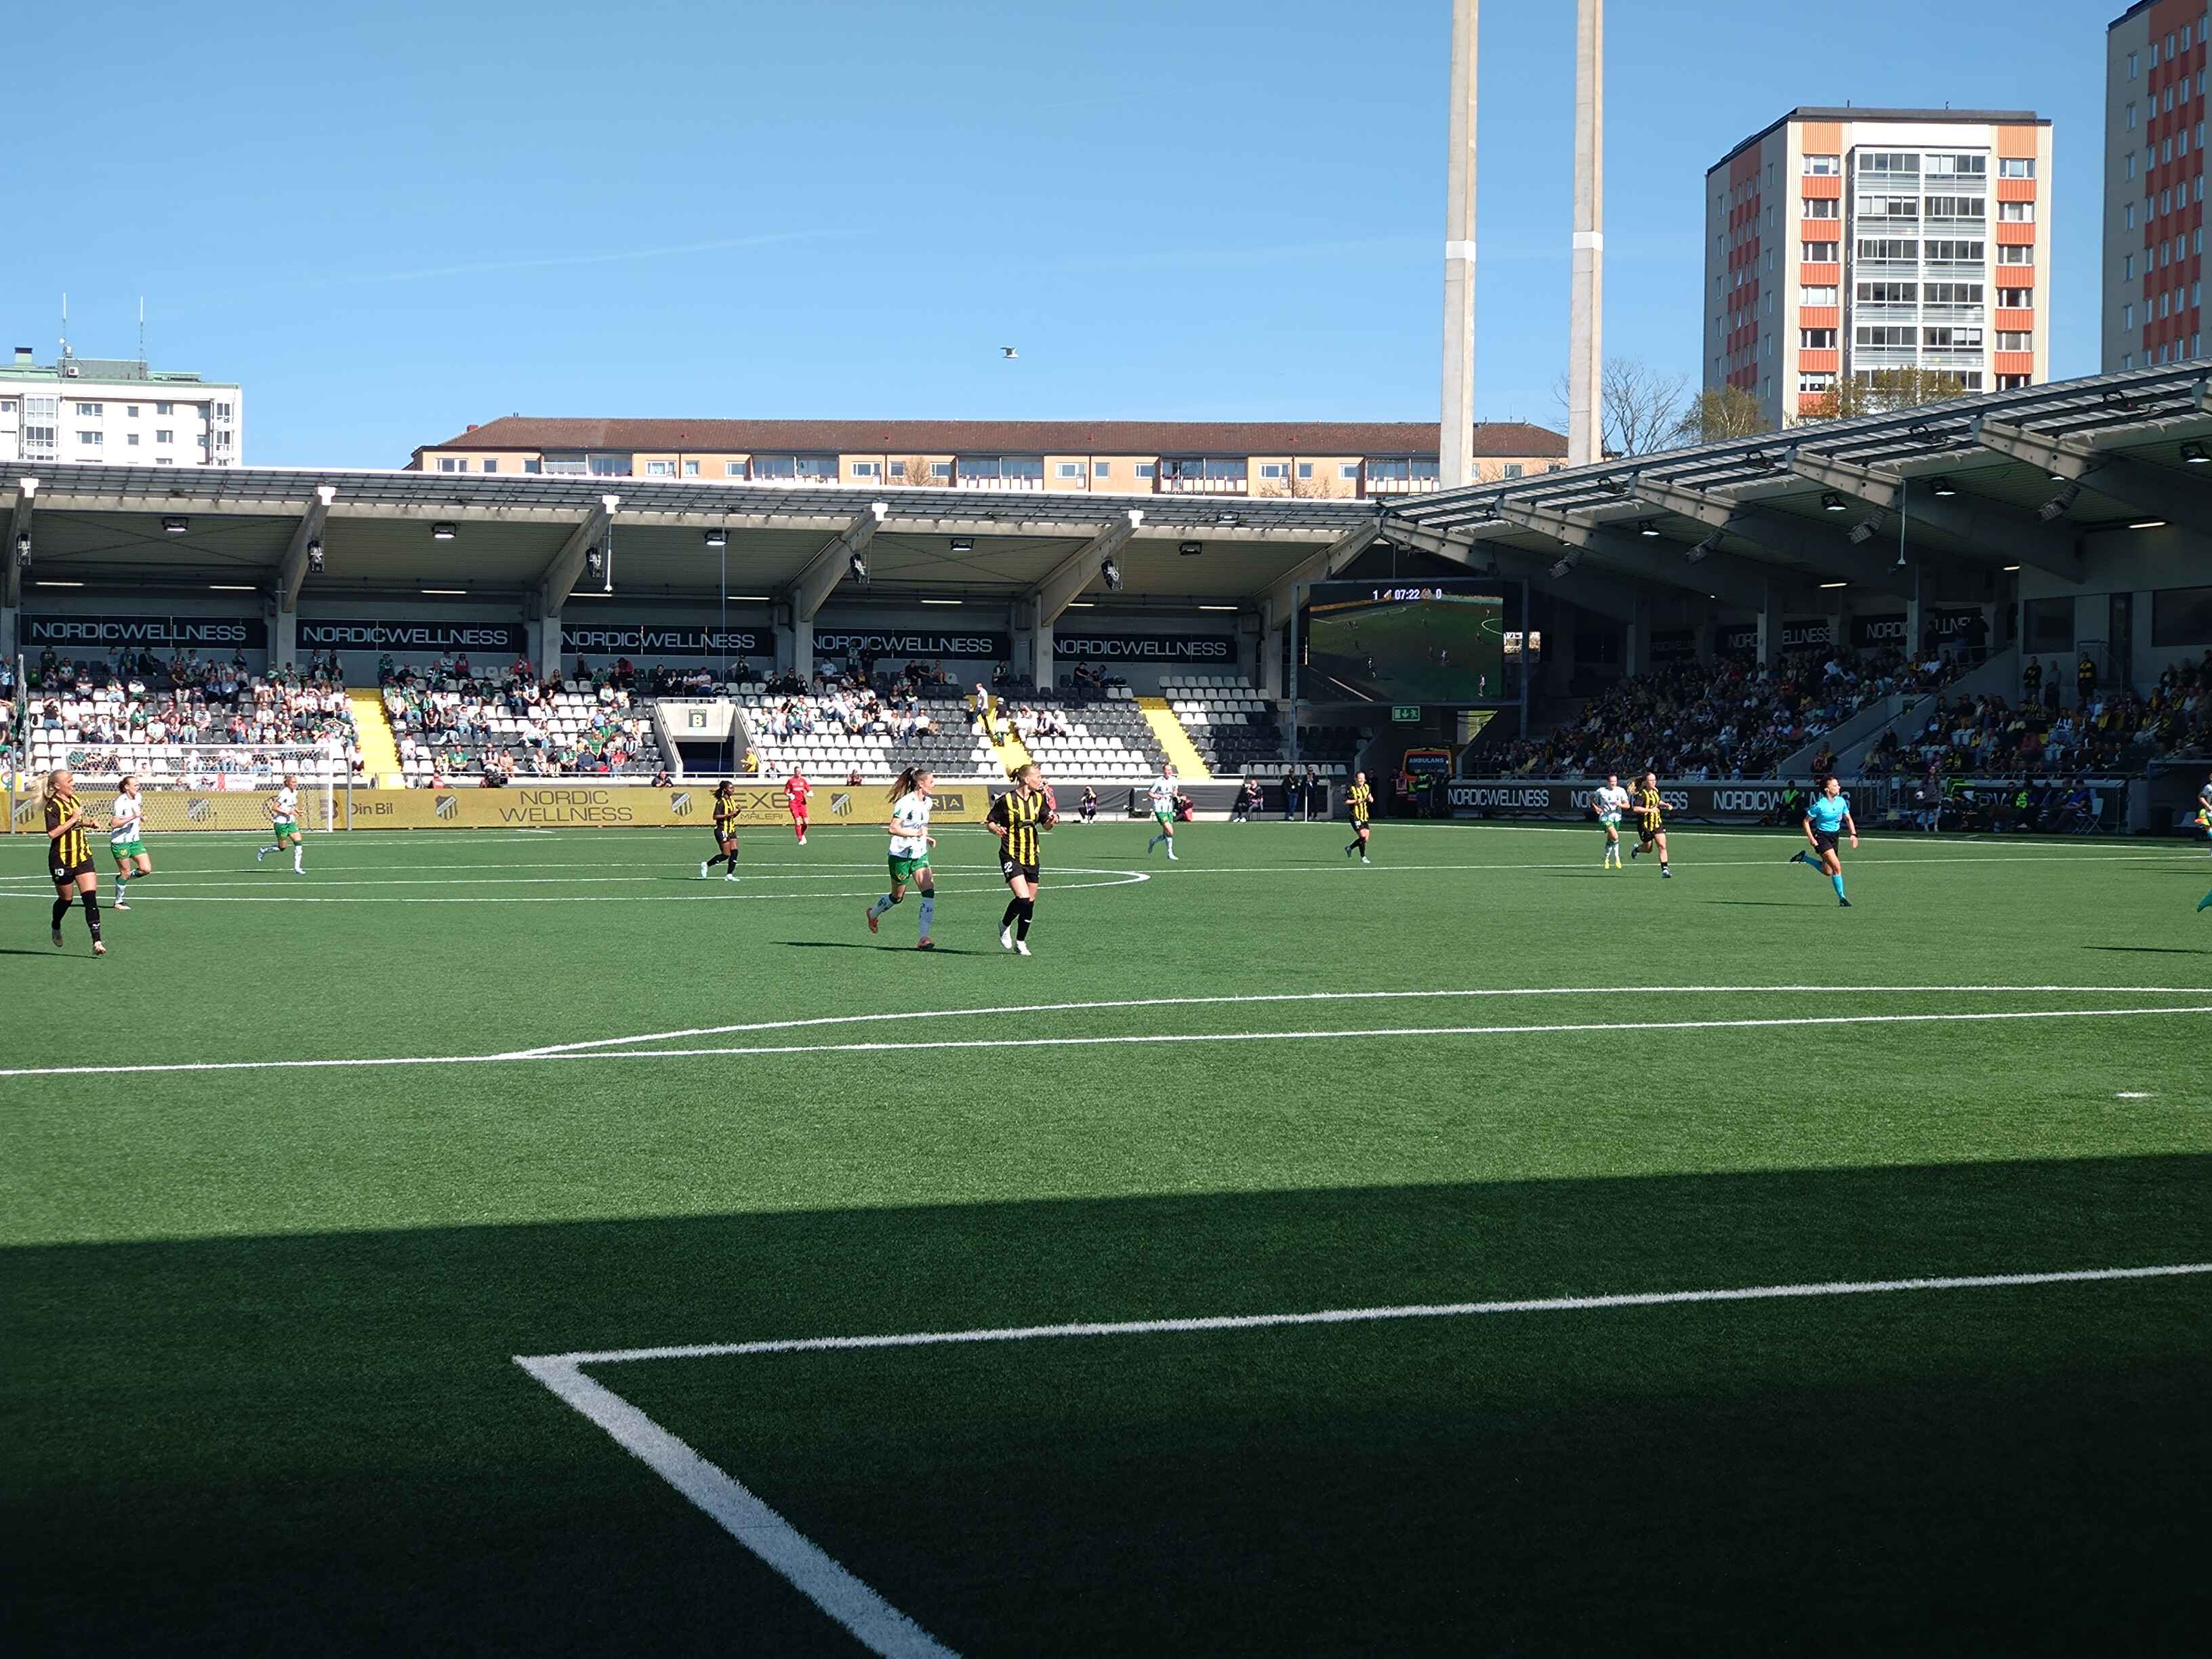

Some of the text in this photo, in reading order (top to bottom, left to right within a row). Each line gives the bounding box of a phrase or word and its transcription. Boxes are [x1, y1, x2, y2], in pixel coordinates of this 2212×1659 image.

[1372, 588, 1442, 600] 1 07:22 0
[33, 622, 247, 641] NORDICWELLNESS
[303, 627, 508, 645] NORDICWELLNESS
[560, 631, 755, 649] NORDICWELLNESS
[693, 714, 703, 726] B
[520, 791, 609, 805] NORDIC
[1448, 790, 1549, 807] NORDICWELLNESS
[375, 802, 393, 815] Bil
[499, 807, 634, 822] WELLNESS
[739, 811, 783, 820] MÅLERI
